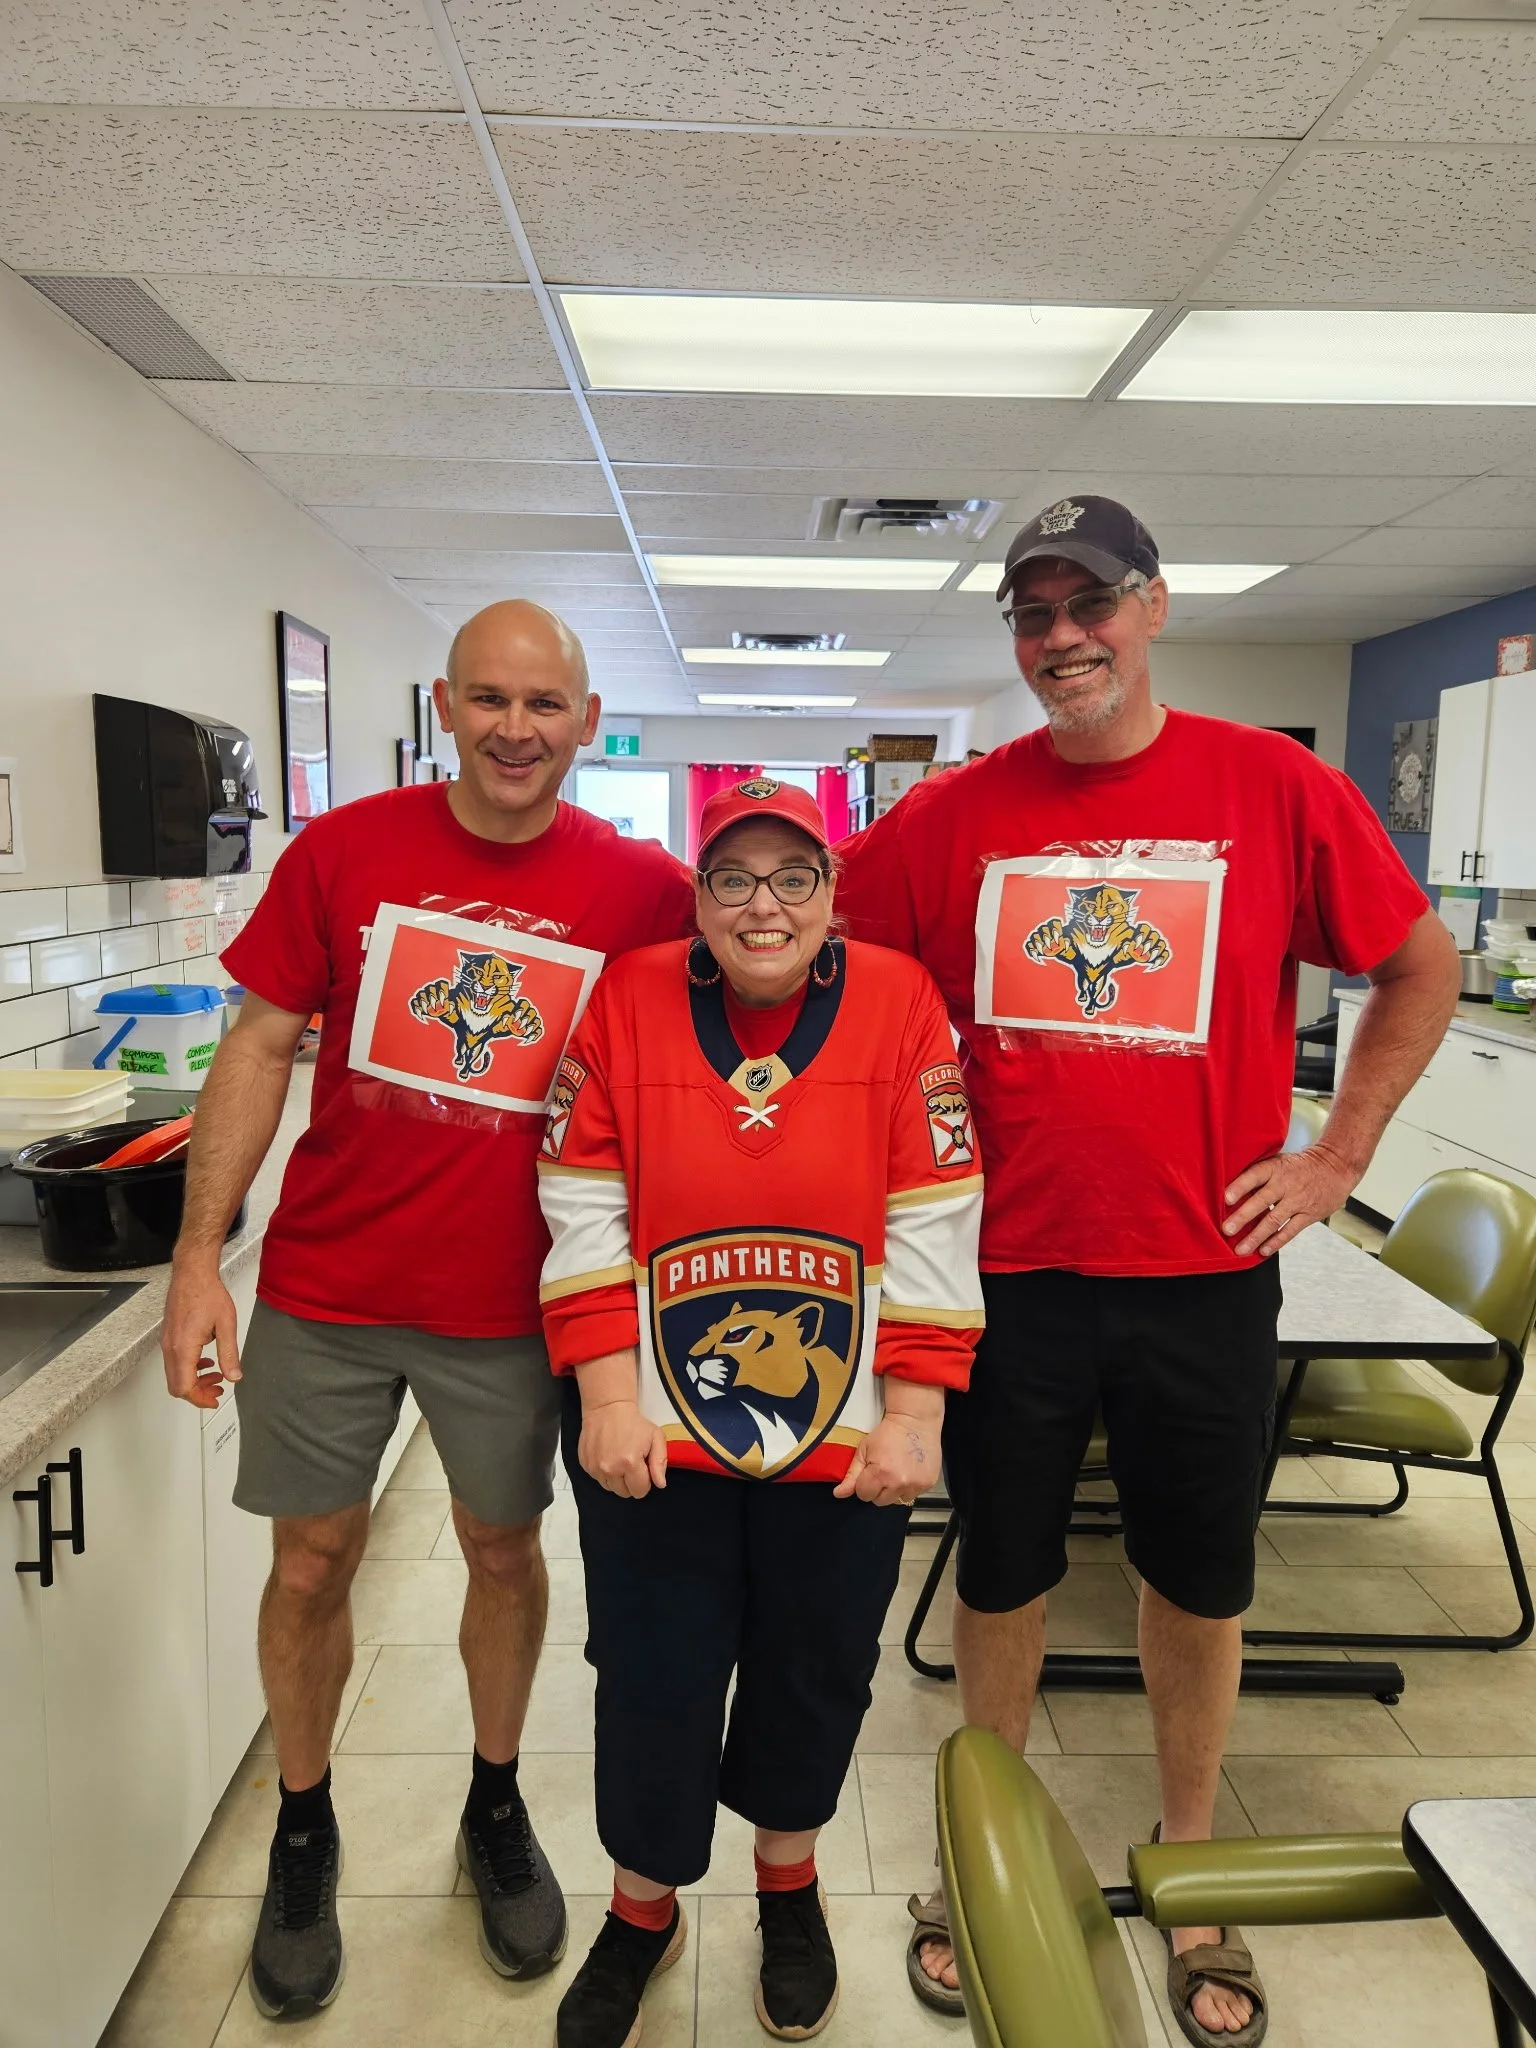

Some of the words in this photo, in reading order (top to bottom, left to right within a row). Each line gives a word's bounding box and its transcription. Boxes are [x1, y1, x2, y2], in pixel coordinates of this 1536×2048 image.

[122, 1049, 161, 1060] COMPOST
[187, 1041, 215, 1059] COMPOST
[121, 1062, 158, 1073] PLEASE
[752, 1069, 767, 1085] NHL
[669, 1247, 840, 1293] PANTHERS
